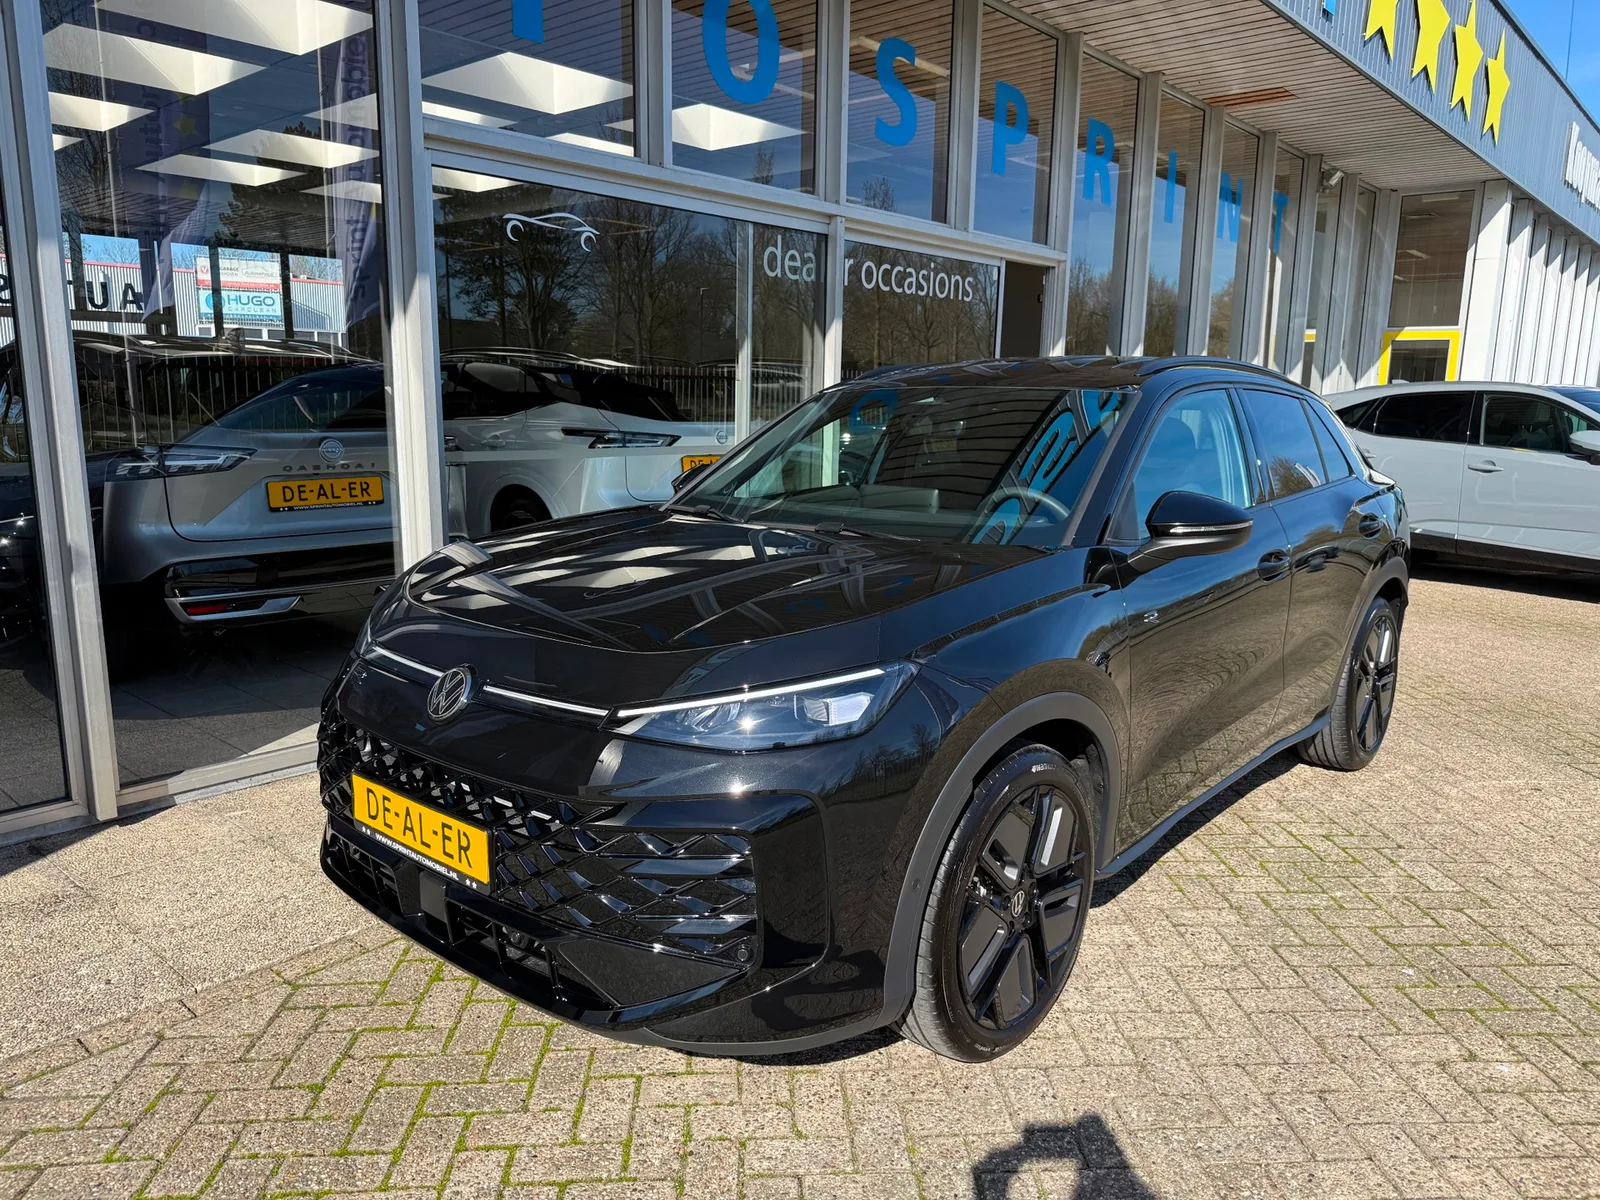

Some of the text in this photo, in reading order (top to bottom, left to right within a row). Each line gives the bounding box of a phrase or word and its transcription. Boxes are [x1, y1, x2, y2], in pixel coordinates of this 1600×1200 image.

[763, 234, 974, 302] dear occasions
[227, 294, 275, 306] HUGO
[283, 462, 375, 472] QASHQAI
[282, 481, 371, 502] DE-AL-ER
[366, 787, 472, 868] DE-AL-ER
[375, 833, 459, 880] WWW.SPRINTAUTOMOBIEL.NL
